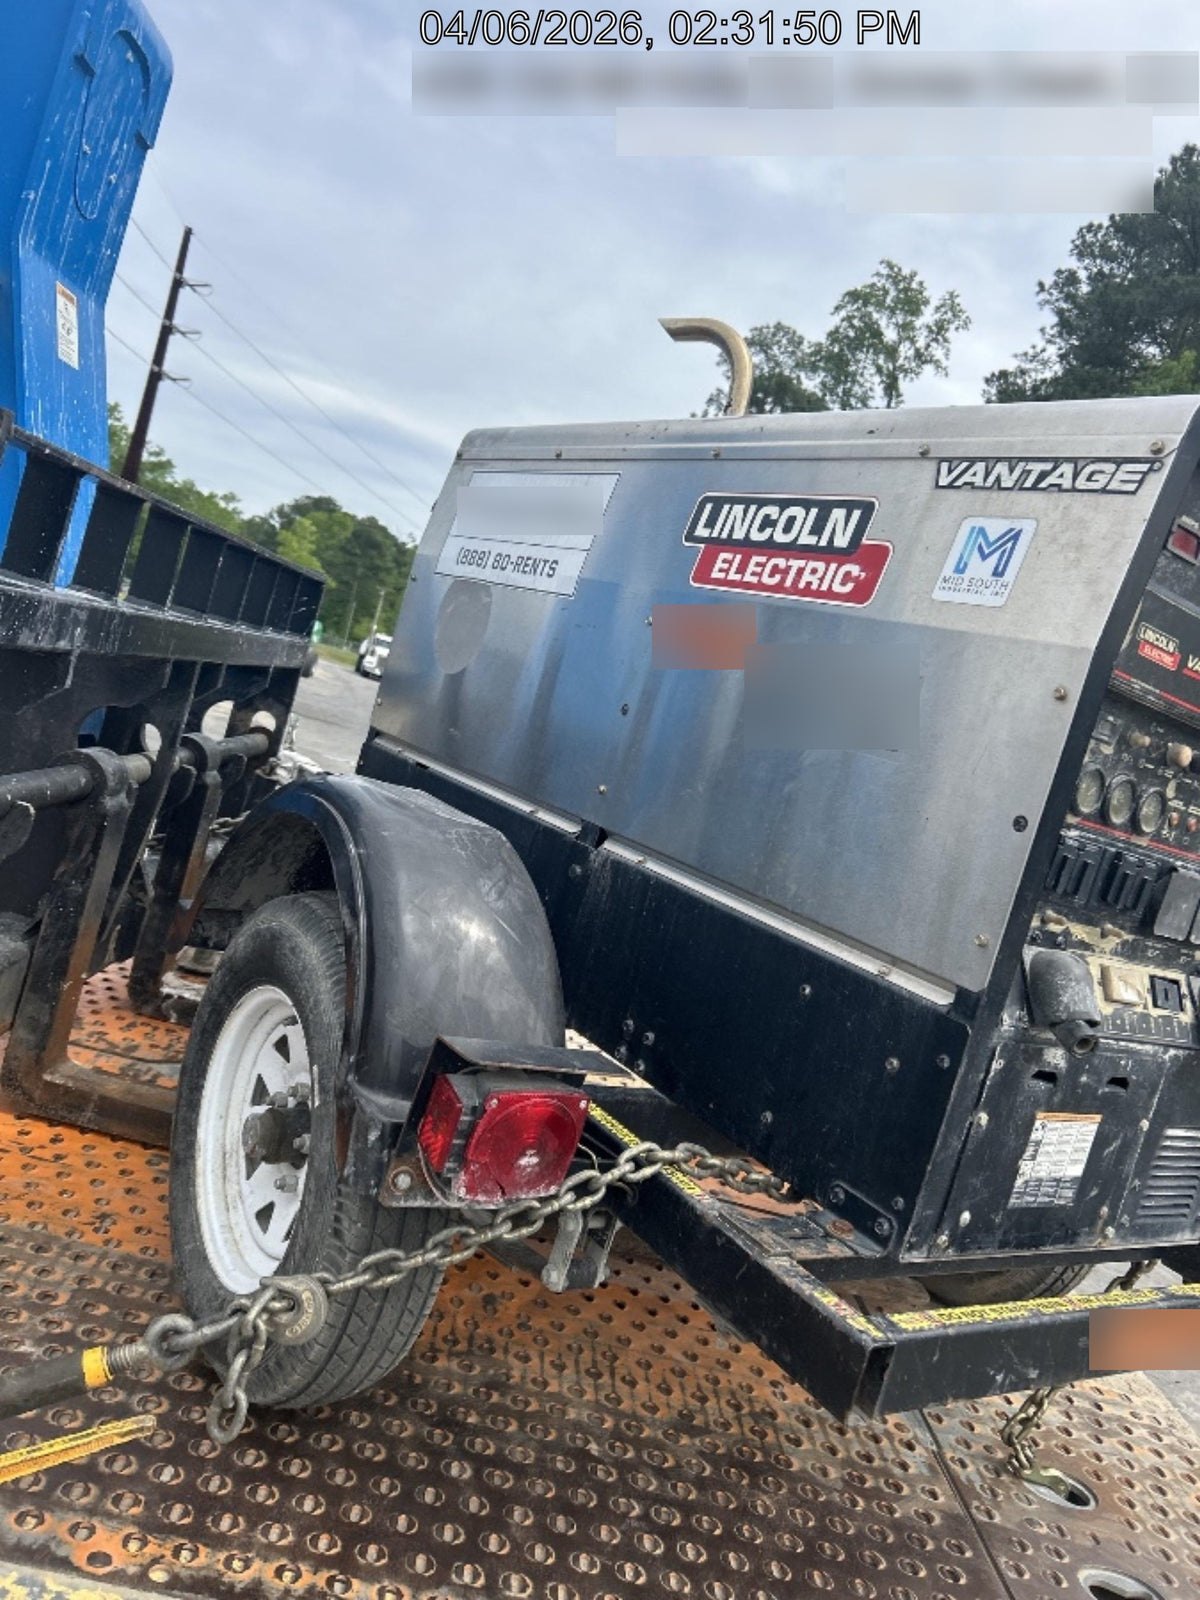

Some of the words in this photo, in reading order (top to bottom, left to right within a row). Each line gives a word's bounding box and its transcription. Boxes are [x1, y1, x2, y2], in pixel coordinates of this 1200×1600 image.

[936, 459, 1152, 495] VANTAGE
[693, 502, 863, 548] LINCOLN
[456, 546, 491, 570] (888)
[710, 552, 863, 594] ELECTRIC
[966, 577, 1009, 591] SOUTH
